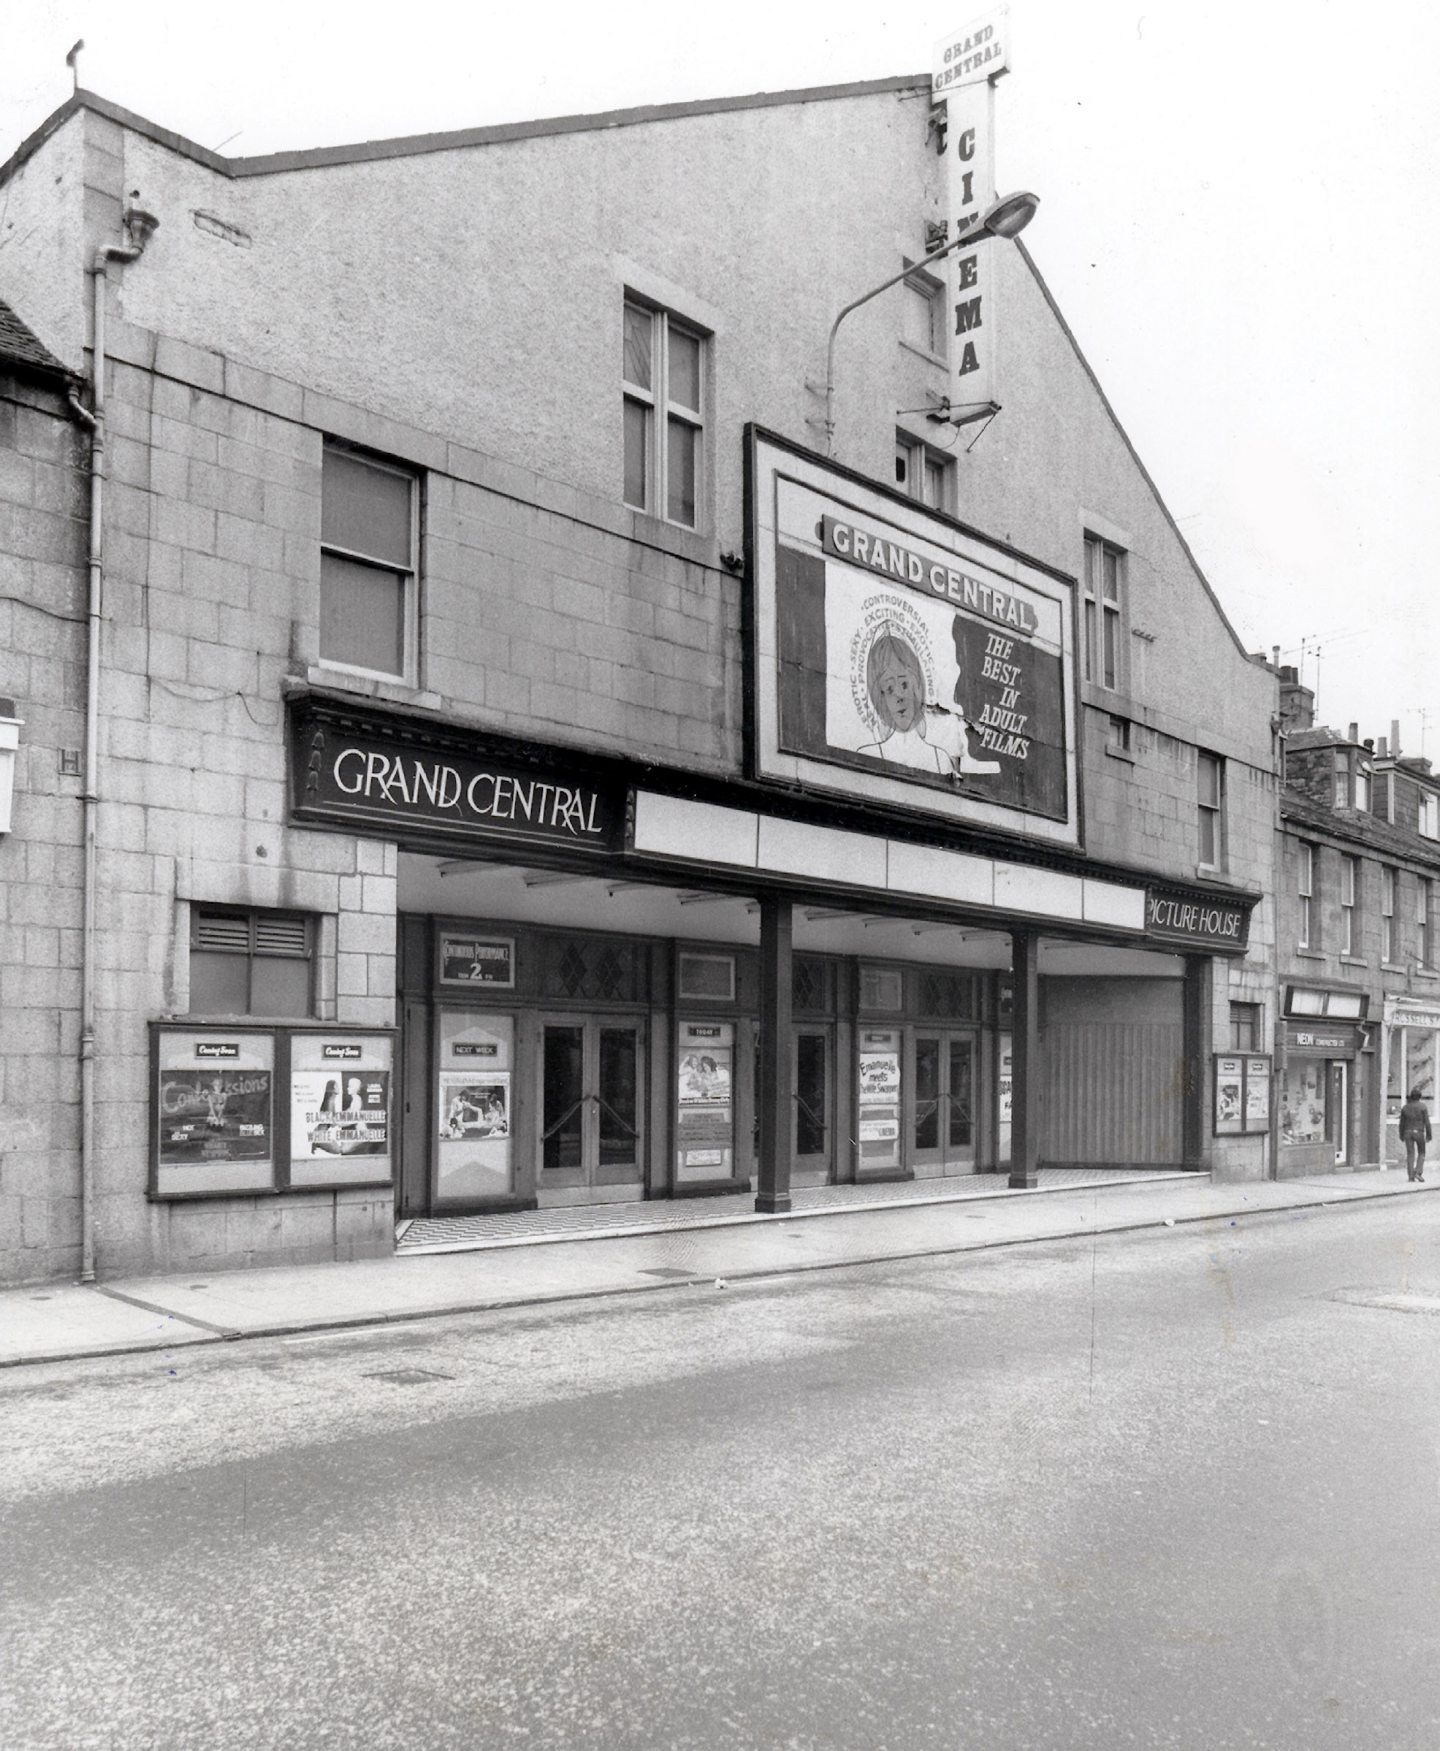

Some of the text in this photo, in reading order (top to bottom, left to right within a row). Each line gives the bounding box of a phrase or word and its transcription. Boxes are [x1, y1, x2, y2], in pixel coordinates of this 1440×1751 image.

[944, 25, 993, 64] GRAND
[935, 42, 1002, 89] CENTRAL
[832, 523, 1033, 631] GRAND CENTRAL
[863, 594, 929, 638] CONTROVERSIAL
[864, 608, 905, 627] EXCITING
[985, 633, 1014, 660] THE
[981, 656, 1021, 686] BEST
[999, 687, 1020, 709] IN
[979, 704, 1028, 734] ADULT
[980, 728, 1030, 759] FILMS
[333, 749, 602, 835] GRAND CENTRAL
[1199, 907, 1241, 937] HOUSE
[470, 963, 483, 980] 2
[456, 1046, 473, 1054] NEXT
[869, 1072, 888, 1082] meets
[306, 1112, 333, 1123] BLACK
[307, 1129, 386, 1142] WHITE EMMANUELLE
